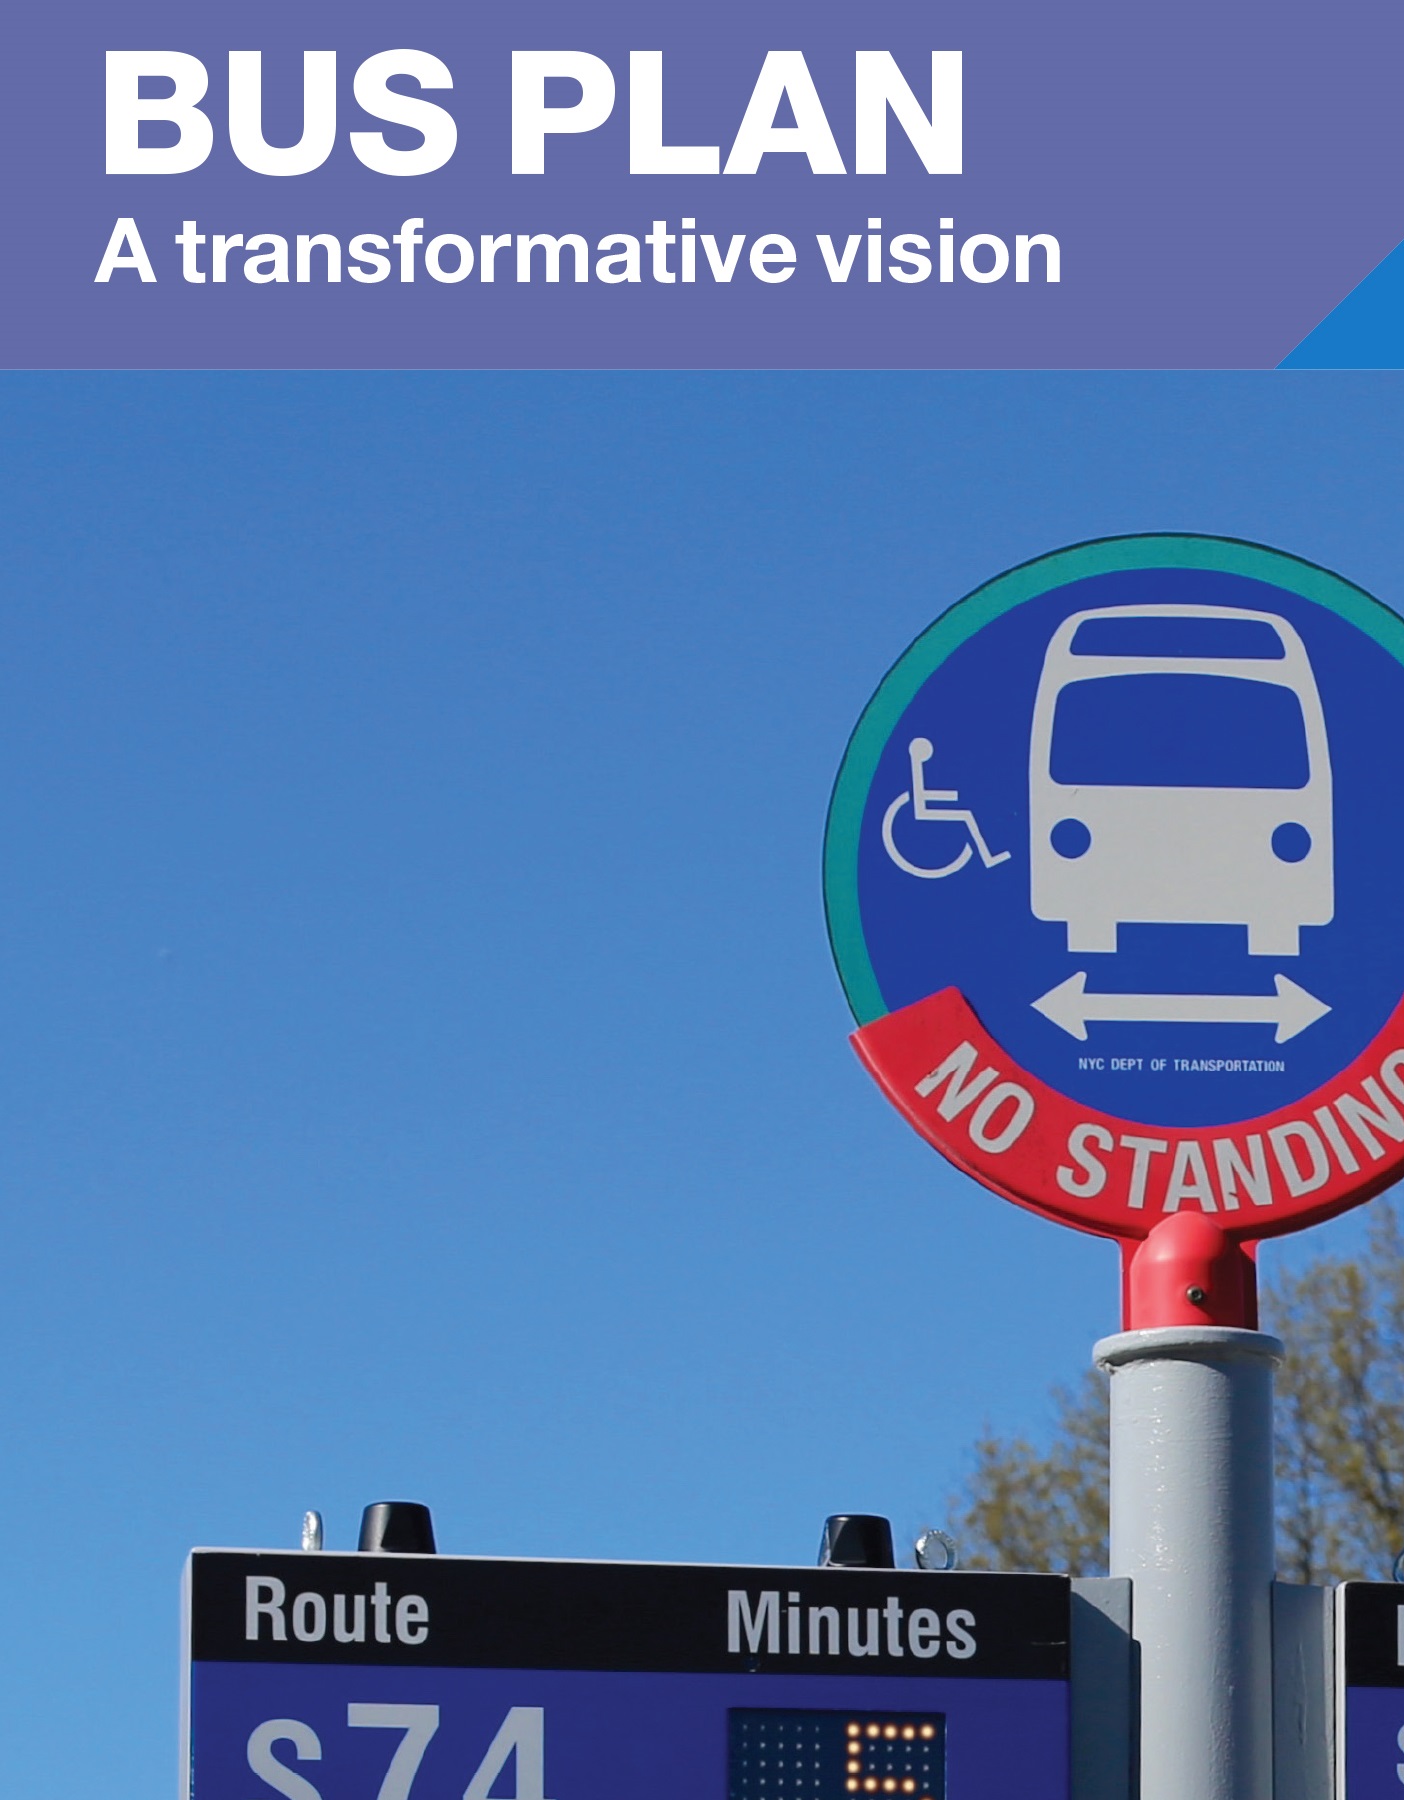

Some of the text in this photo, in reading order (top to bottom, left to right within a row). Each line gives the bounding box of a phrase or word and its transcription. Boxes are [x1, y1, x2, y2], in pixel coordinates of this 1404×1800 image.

[914, 1040, 1035, 1154] NO
[1078, 1057, 1285, 1072] NYC DEPT OF TRANSPORTATION
[245, 1575, 430, 1645] Route
[727, 1589, 979, 1659] Minutes
